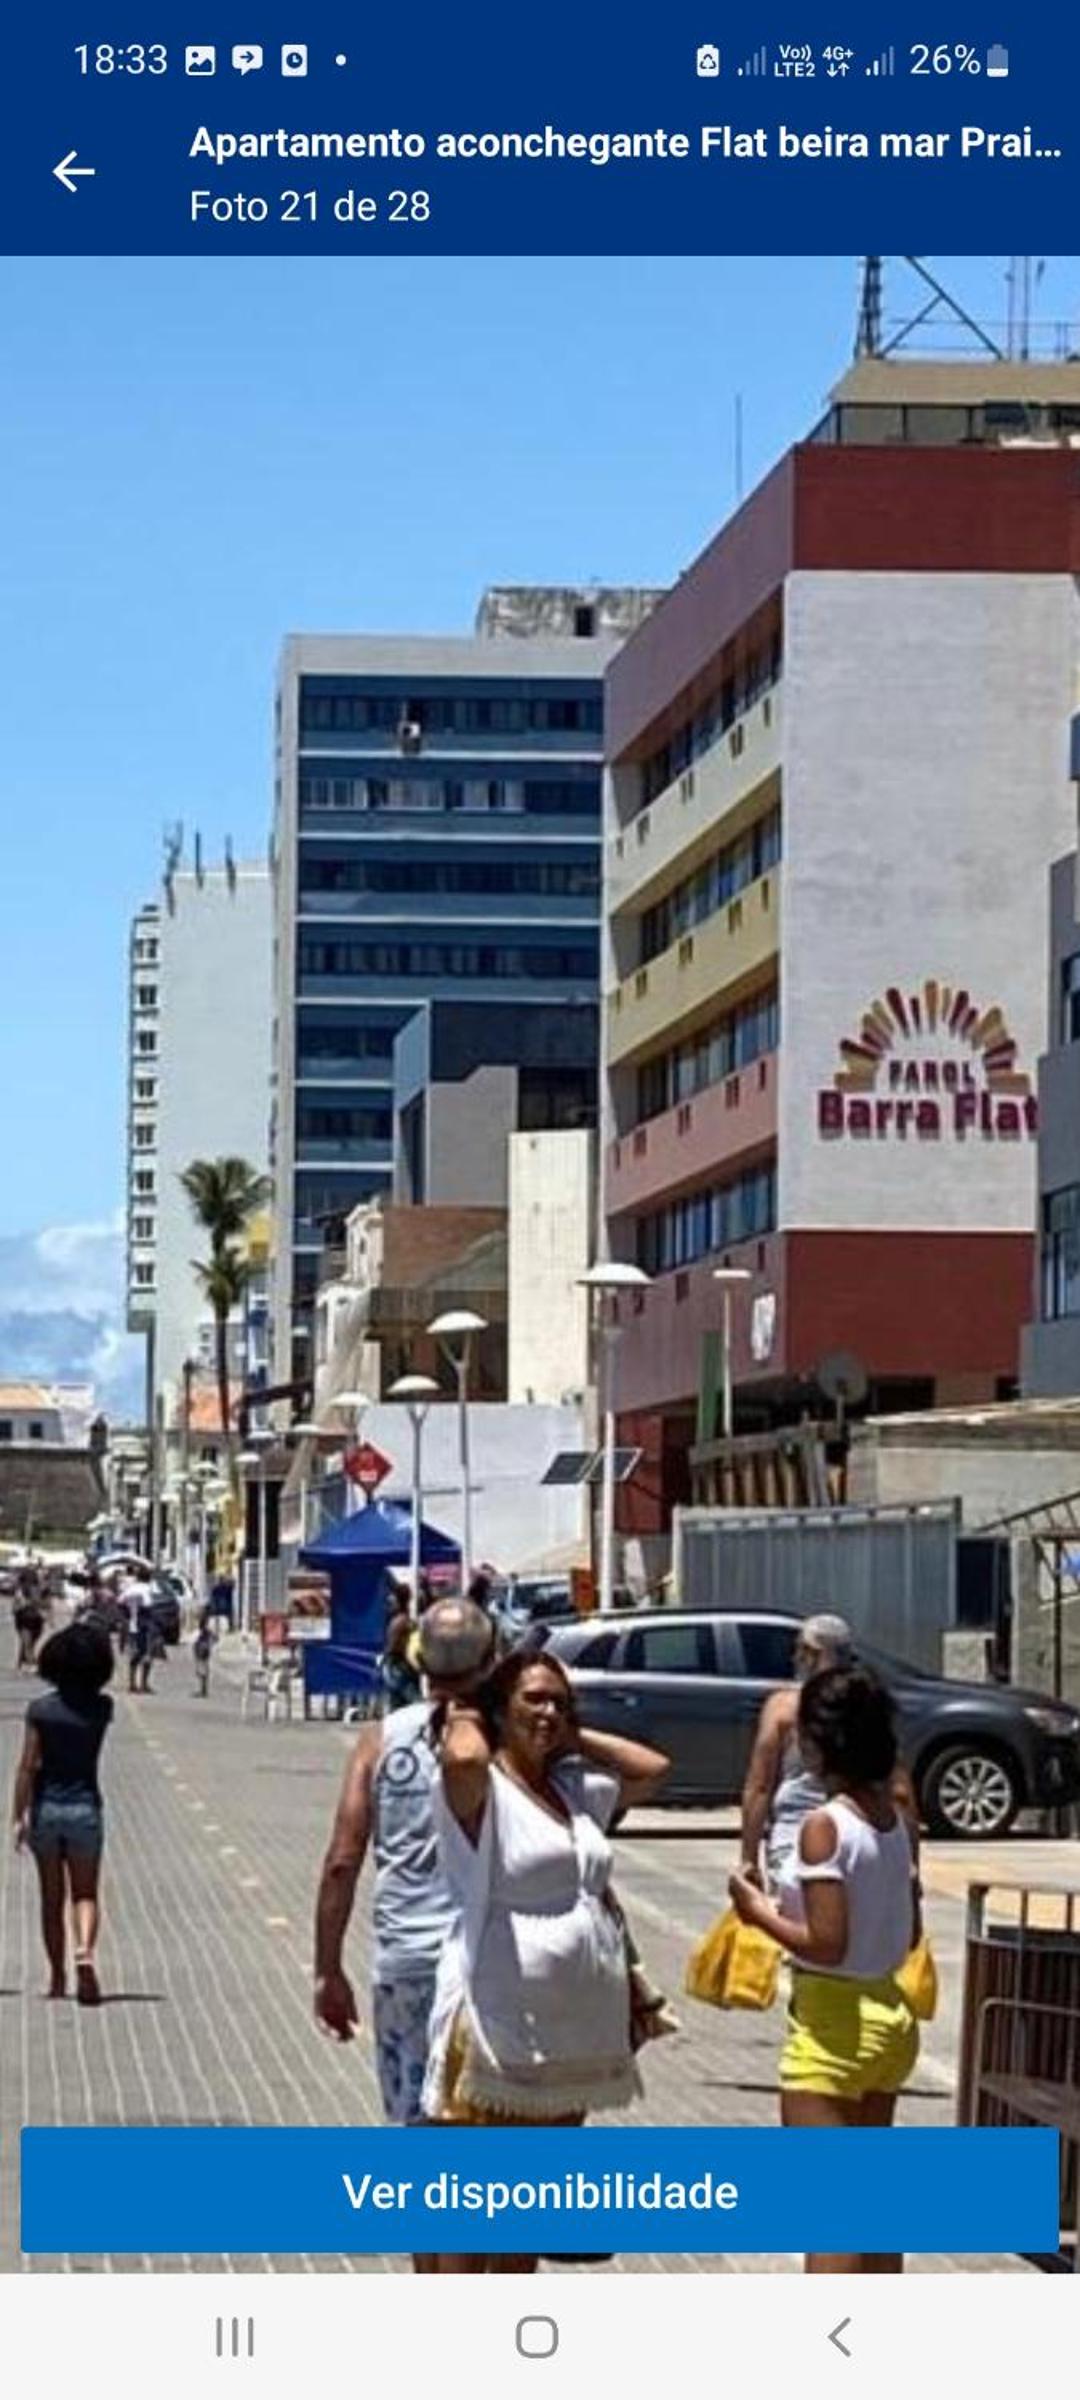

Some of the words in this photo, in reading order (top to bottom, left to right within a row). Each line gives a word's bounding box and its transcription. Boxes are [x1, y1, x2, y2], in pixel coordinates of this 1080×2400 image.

[889, 1060, 976, 1090] FAROL
[818, 1090, 940, 1138] Barra
[954, 1090, 1039, 1138] Flat
